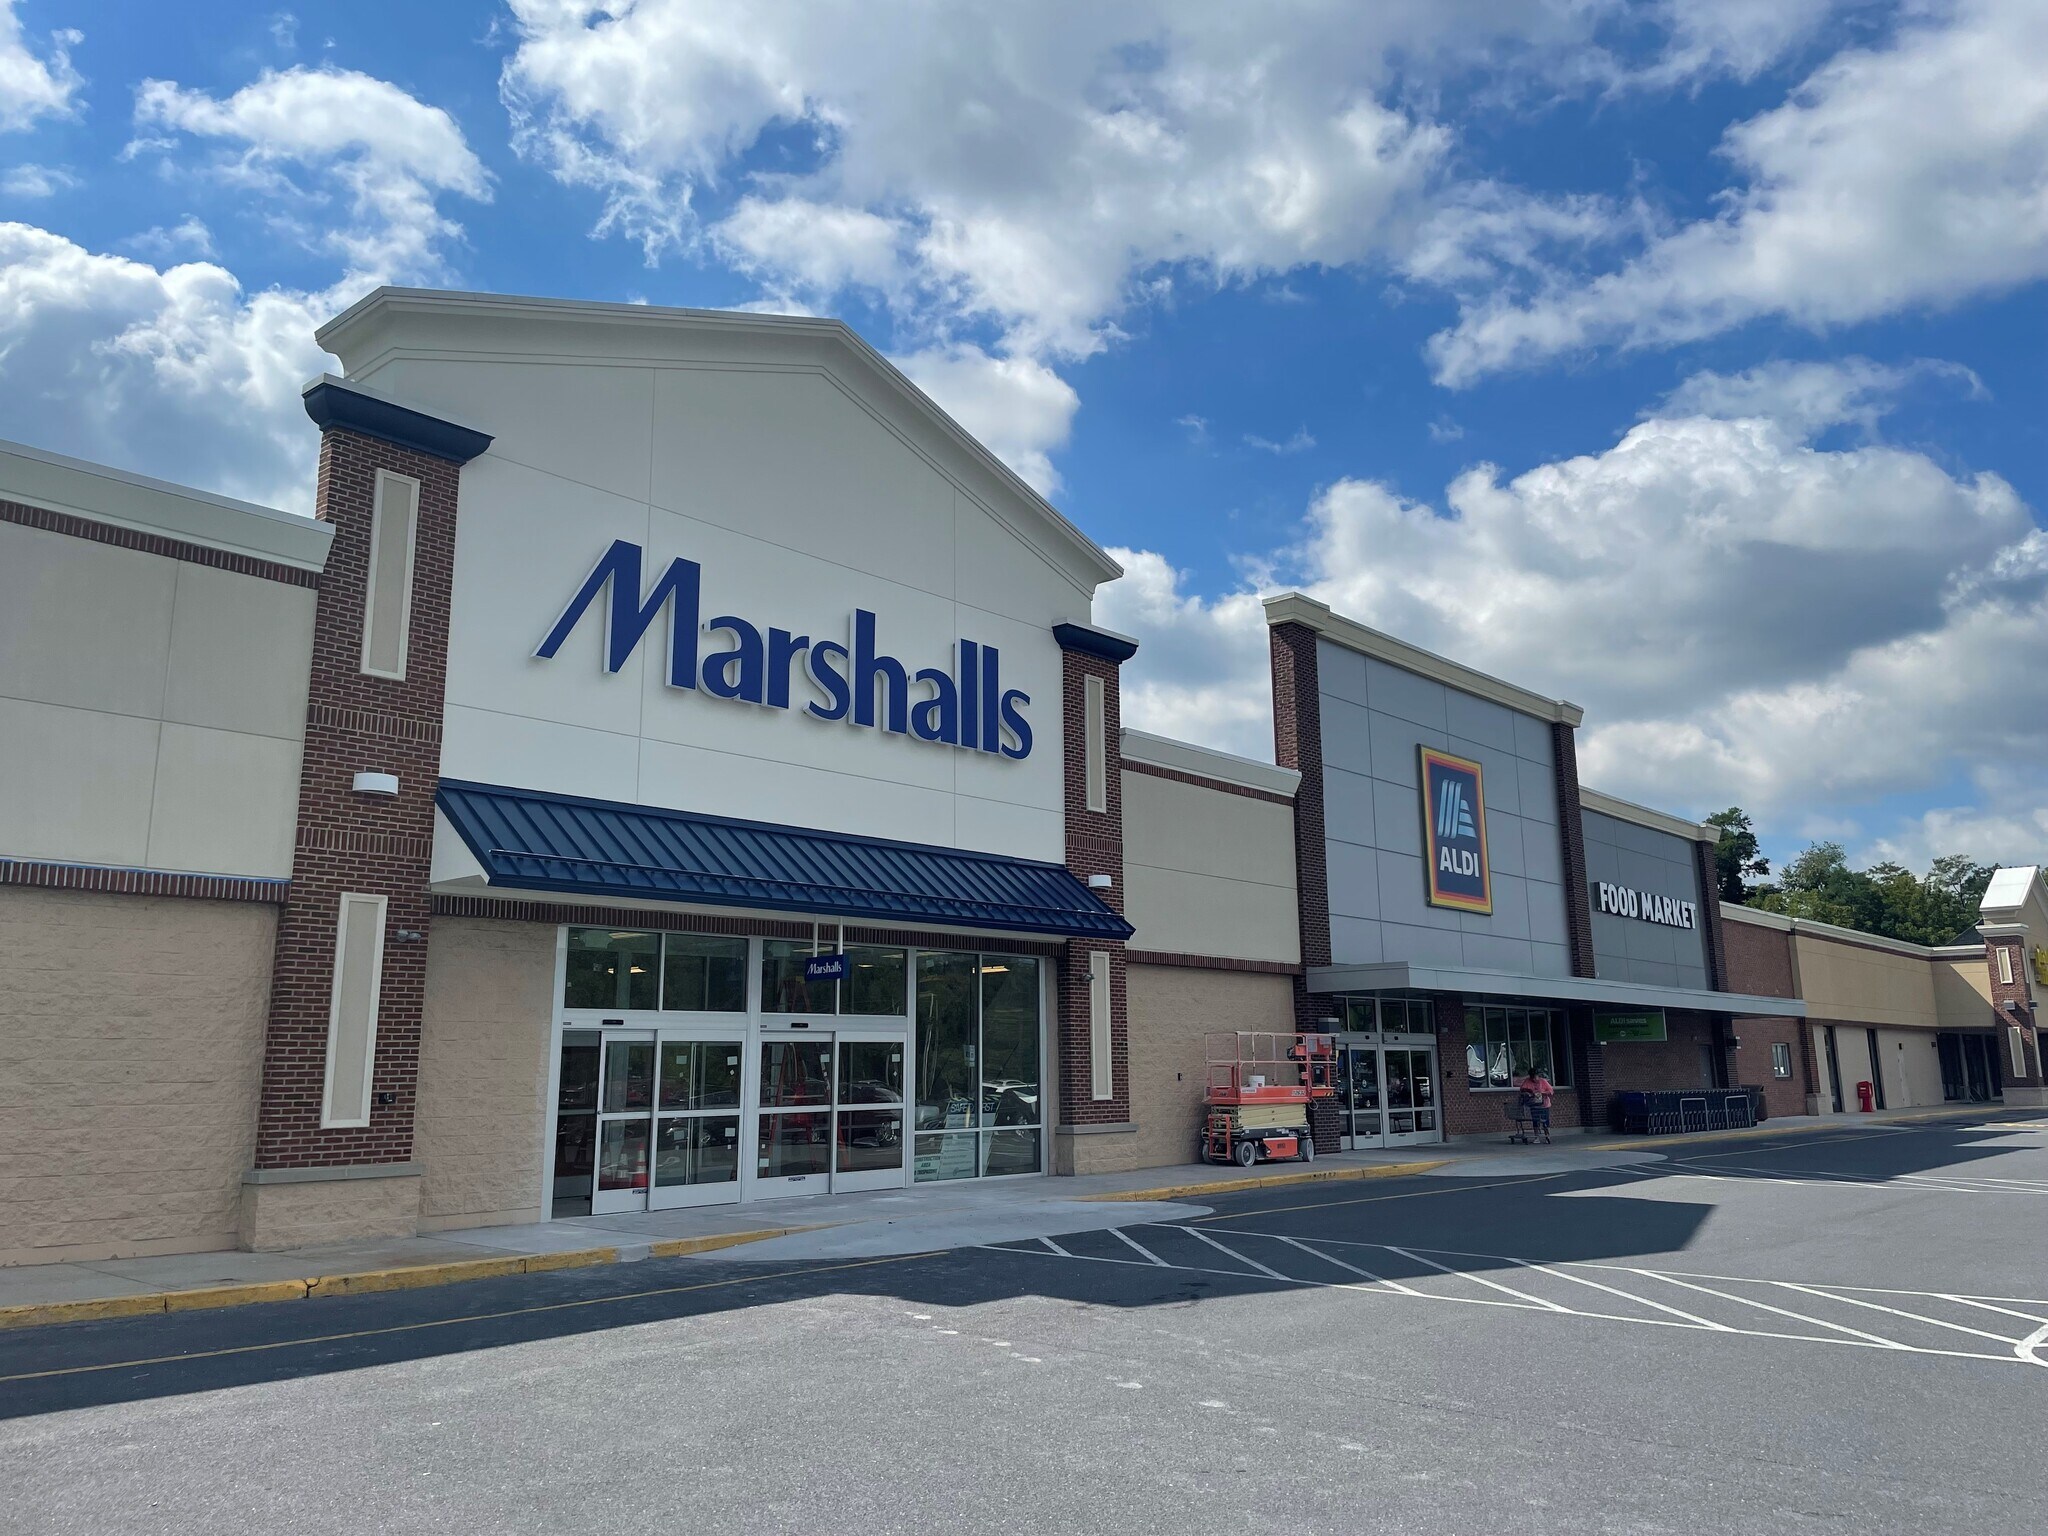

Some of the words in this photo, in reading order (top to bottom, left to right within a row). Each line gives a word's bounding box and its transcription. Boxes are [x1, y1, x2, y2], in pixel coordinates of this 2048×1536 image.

[532, 539, 1033, 761] Marshalls
[1440, 846, 1480, 878] ALDI
[1599, 881, 1638, 918] FOOD
[1640, 891, 1696, 929] MARKET
[806, 960, 842, 975] Marshalls
